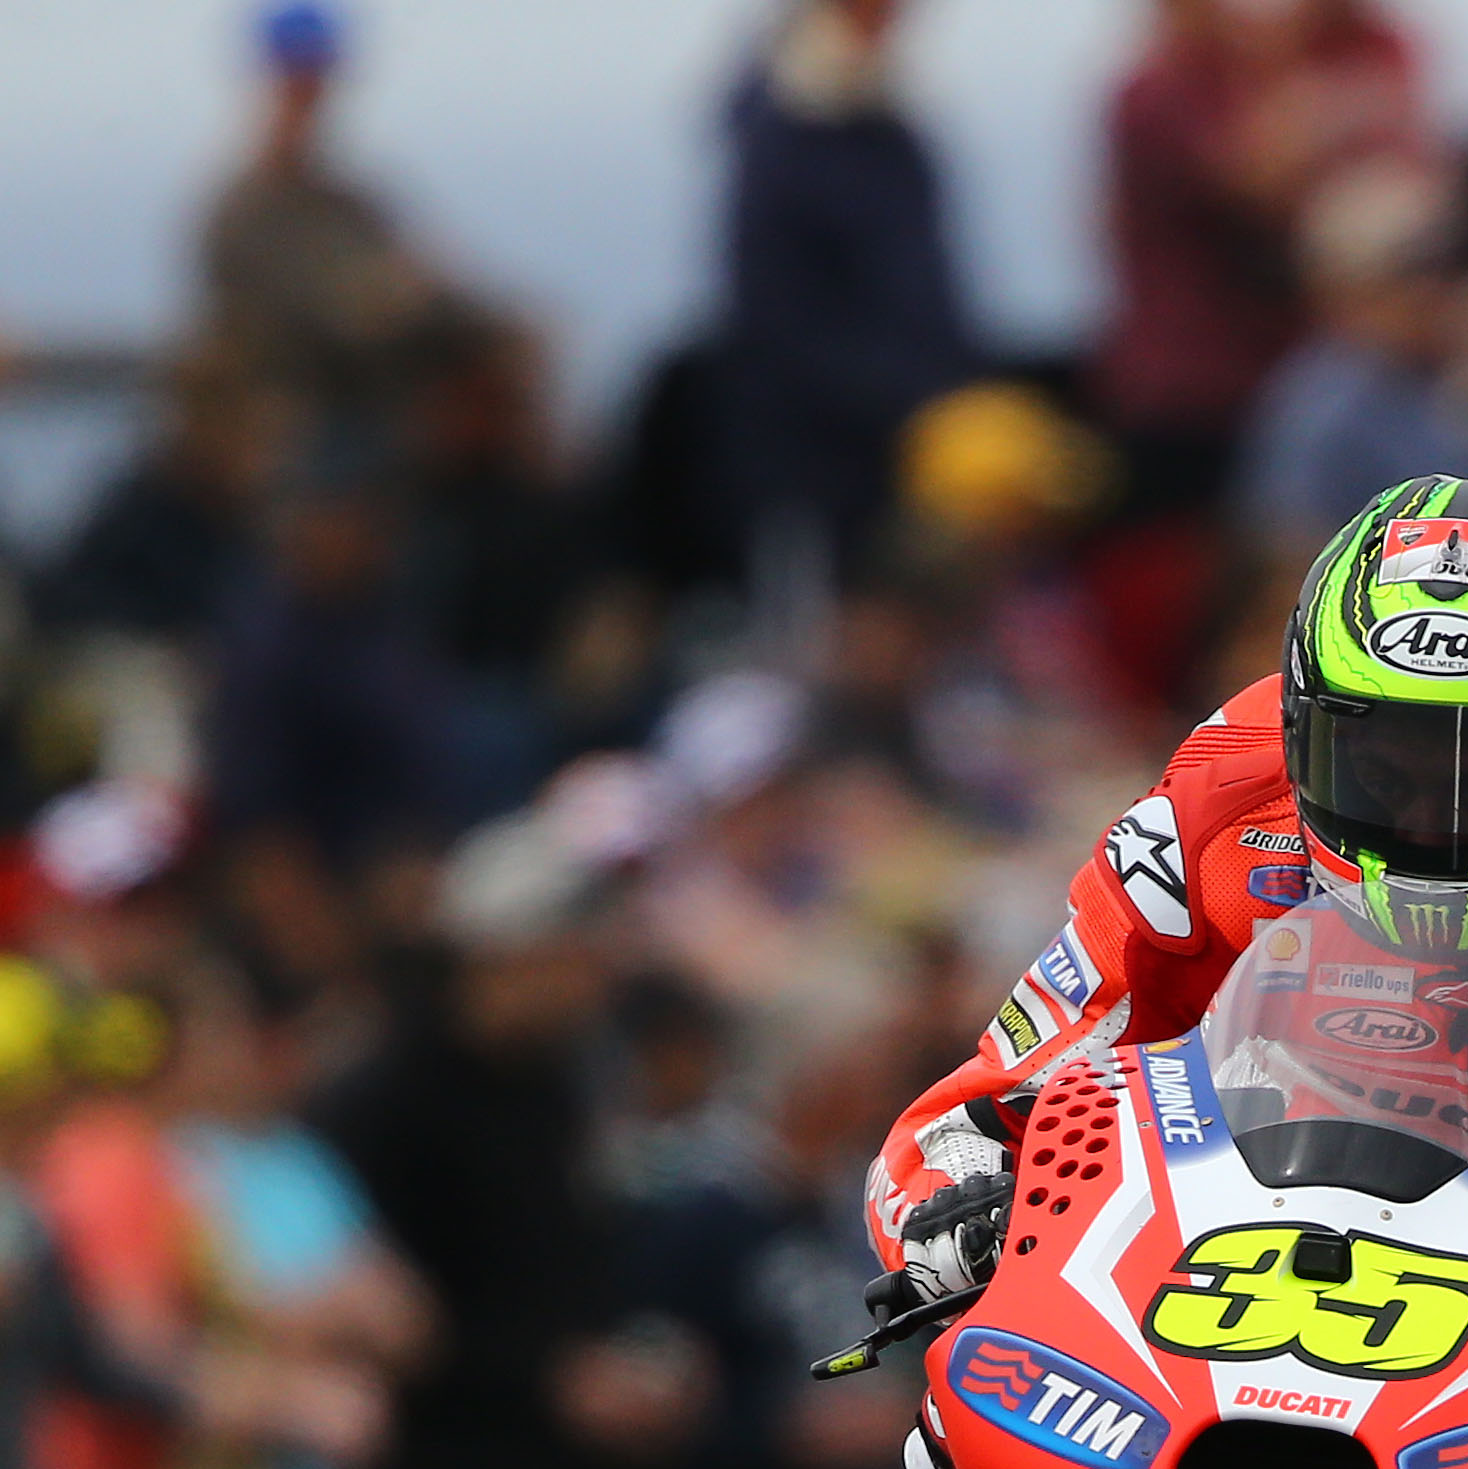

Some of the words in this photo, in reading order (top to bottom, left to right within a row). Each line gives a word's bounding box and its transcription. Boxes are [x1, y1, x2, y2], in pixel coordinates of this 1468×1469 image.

[1411, 659, 1464, 669] HELMET
[1241, 828, 1302, 852] BRIDG
[1045, 942, 1082, 997] TIM
[1341, 968, 1384, 989] riello
[1387, 981, 1409, 994] ups
[1327, 1011, 1421, 1041] Arai
[1147, 1055, 1205, 1145] ADVANCE
[1028, 1371, 1146, 1461] TIM
[1234, 1385, 1351, 1420] DUCATI
